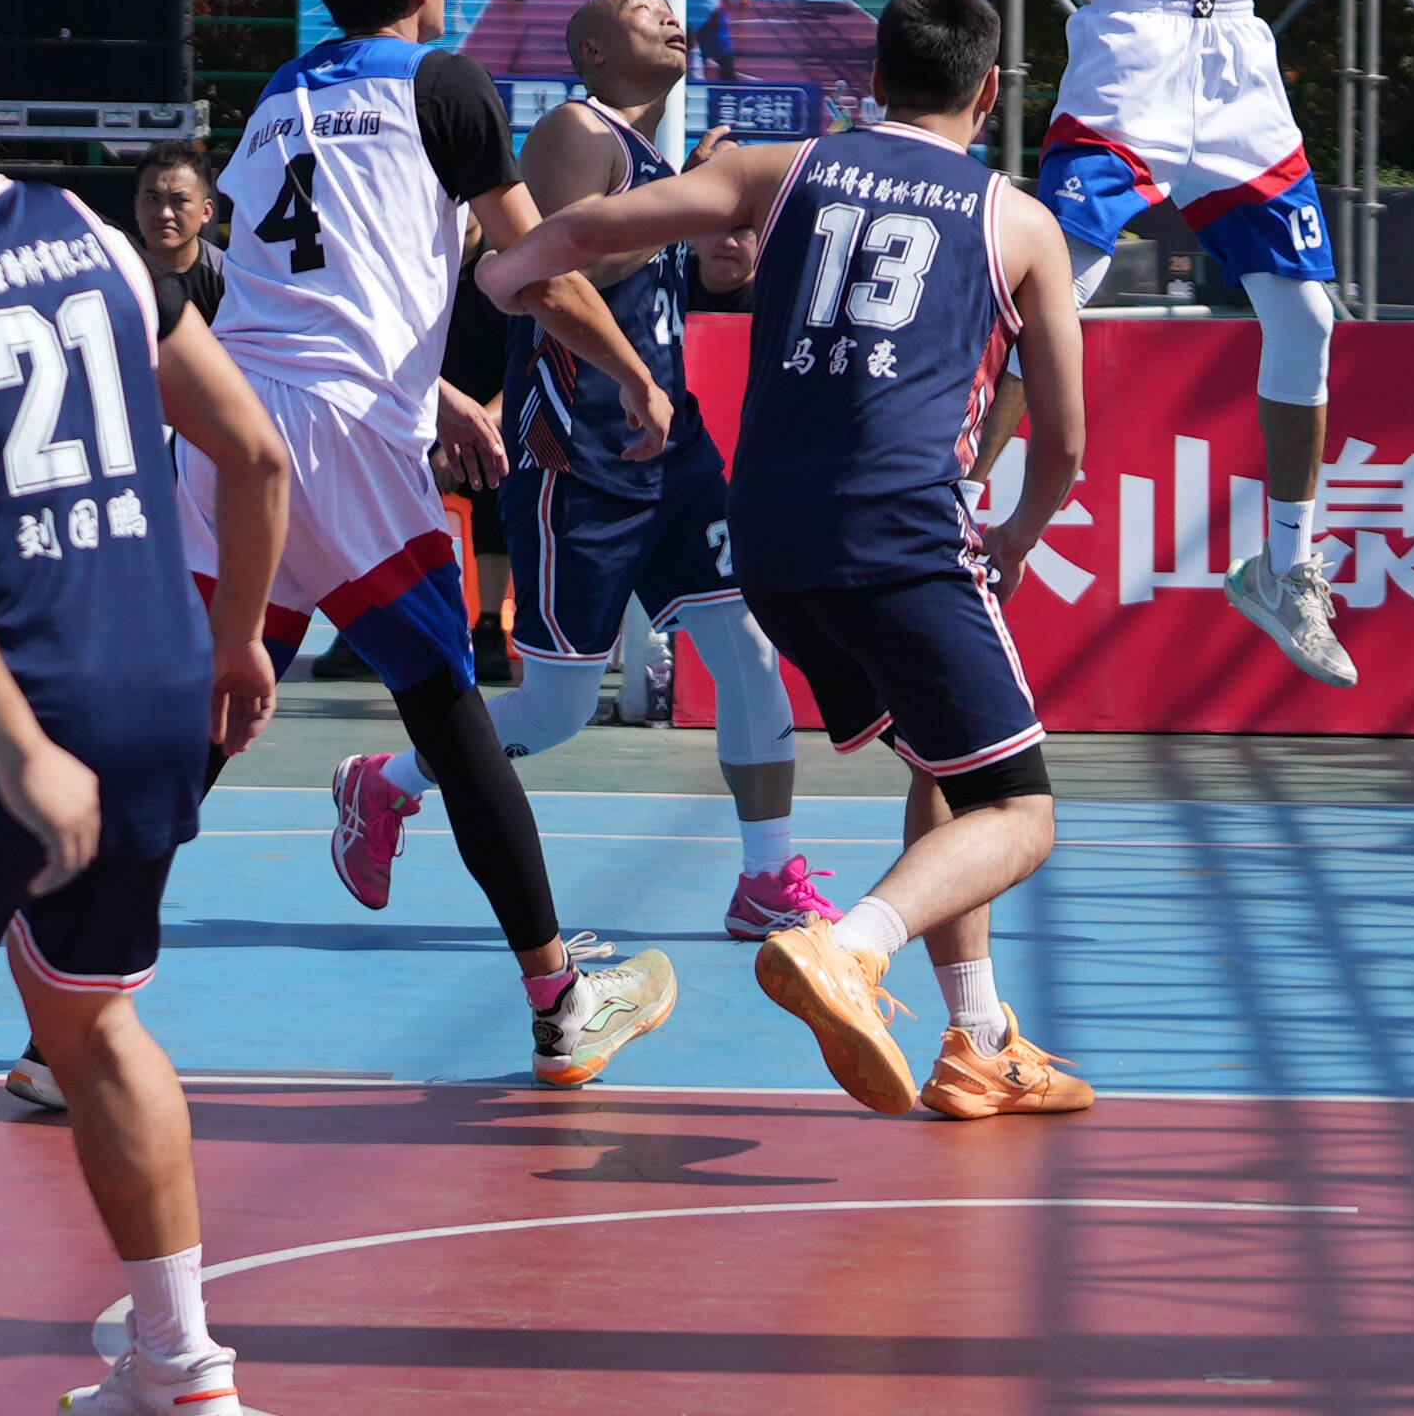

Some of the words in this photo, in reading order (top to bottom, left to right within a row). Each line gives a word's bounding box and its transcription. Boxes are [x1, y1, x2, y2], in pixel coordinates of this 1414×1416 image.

[255, 153, 326, 274] 4
[806, 201, 941, 332] 13
[1288, 205, 1322, 252] 13
